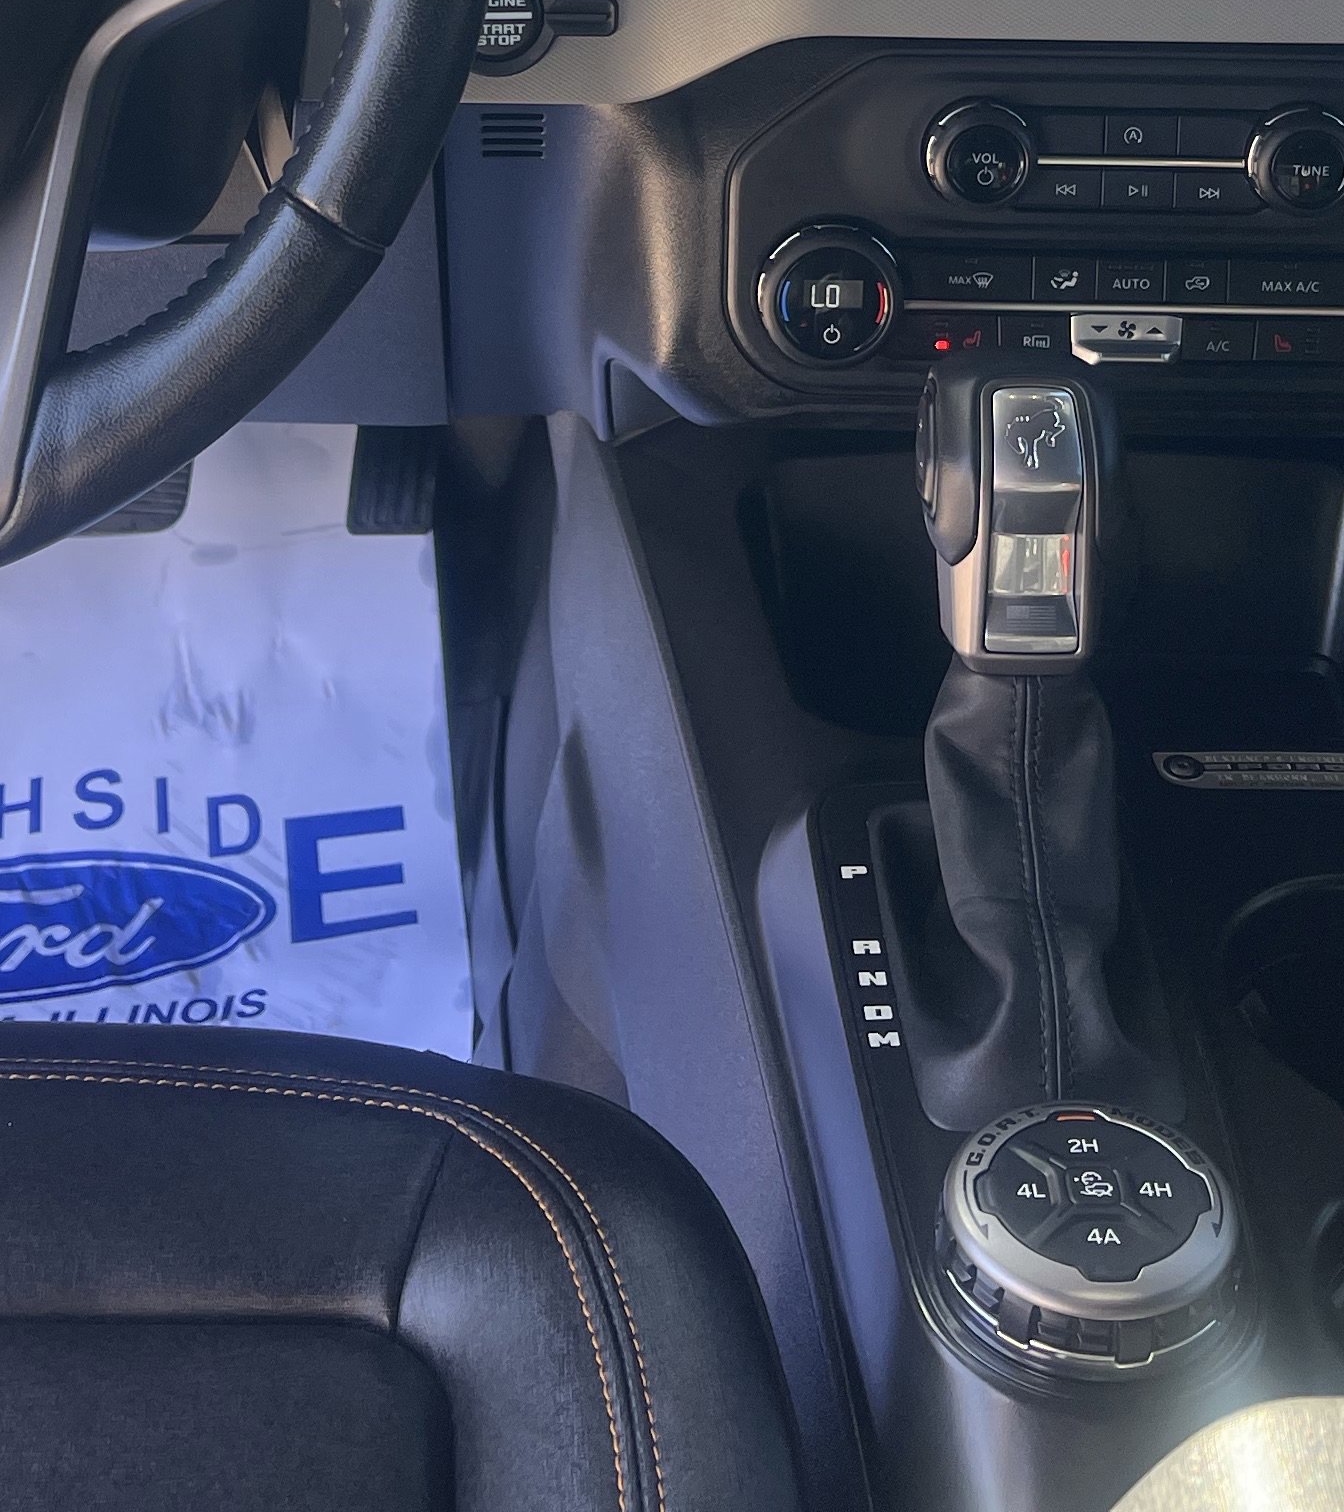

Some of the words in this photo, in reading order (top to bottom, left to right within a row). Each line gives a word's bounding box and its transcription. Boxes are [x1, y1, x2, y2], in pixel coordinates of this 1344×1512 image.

[482, 23, 526, 35] TART
[477, 34, 521, 47] STOP
[971, 152, 999, 165] VOL
[1292, 164, 1330, 177] TUNE
[948, 275, 972, 286] MAX
[1112, 278, 1151, 290] AUTO
[1261, 280, 1292, 293] MAX
[1295, 281, 1321, 295] A/C
[1206, 340, 1231, 354] A/C
[840, 865, 868, 878] P
[858, 972, 887, 986] N
[863, 1005, 893, 1020] D
[867, 1032, 900, 1047] M
[1111, 1107, 1207, 1166] MODES
[1067, 1138, 1099, 1153] 2H
[1016, 1183, 1046, 1198] 4L
[1139, 1182, 1173, 1197] 4H
[1086, 1228, 1121, 1245] 4A
